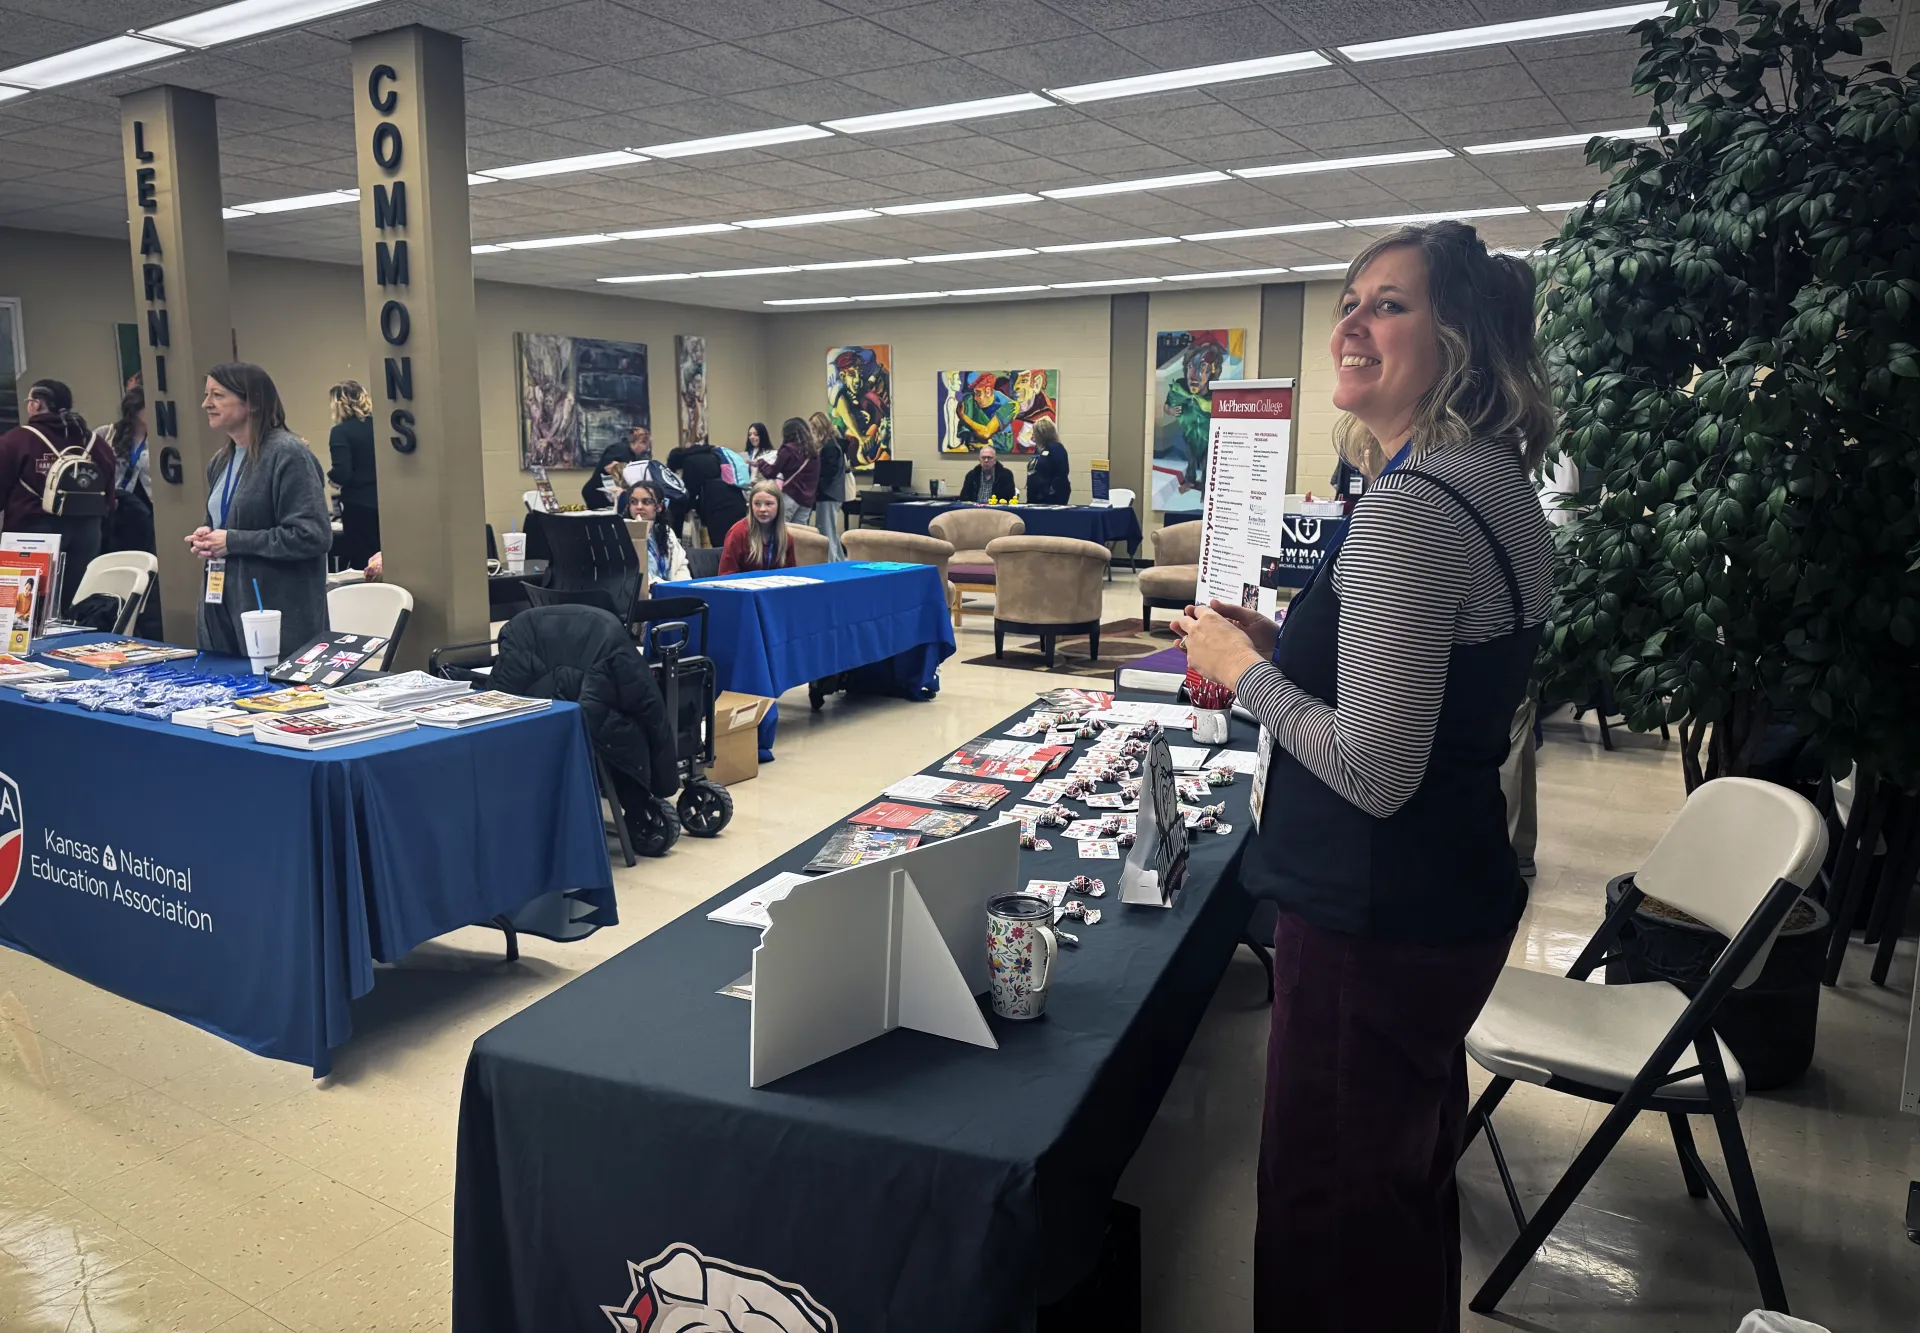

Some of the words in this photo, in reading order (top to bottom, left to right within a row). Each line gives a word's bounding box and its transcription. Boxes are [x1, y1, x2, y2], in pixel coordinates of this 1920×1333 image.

[368, 64, 417, 455] COMMONS
[133, 121, 184, 486] LEARNING
[1218, 399, 1256, 413] McPherson
[1256, 399, 1283, 415] College
[1201, 535, 1211, 583] Follow
[1206, 495, 1214, 531] your
[1280, 548, 1325, 559] EWMA
[1280, 556, 1322, 564] IVERSIT
[31, 854, 109, 899] Education
[113, 880, 213, 932] Association
[44, 828, 99, 865] Kansas
[120, 849, 192, 893] National
